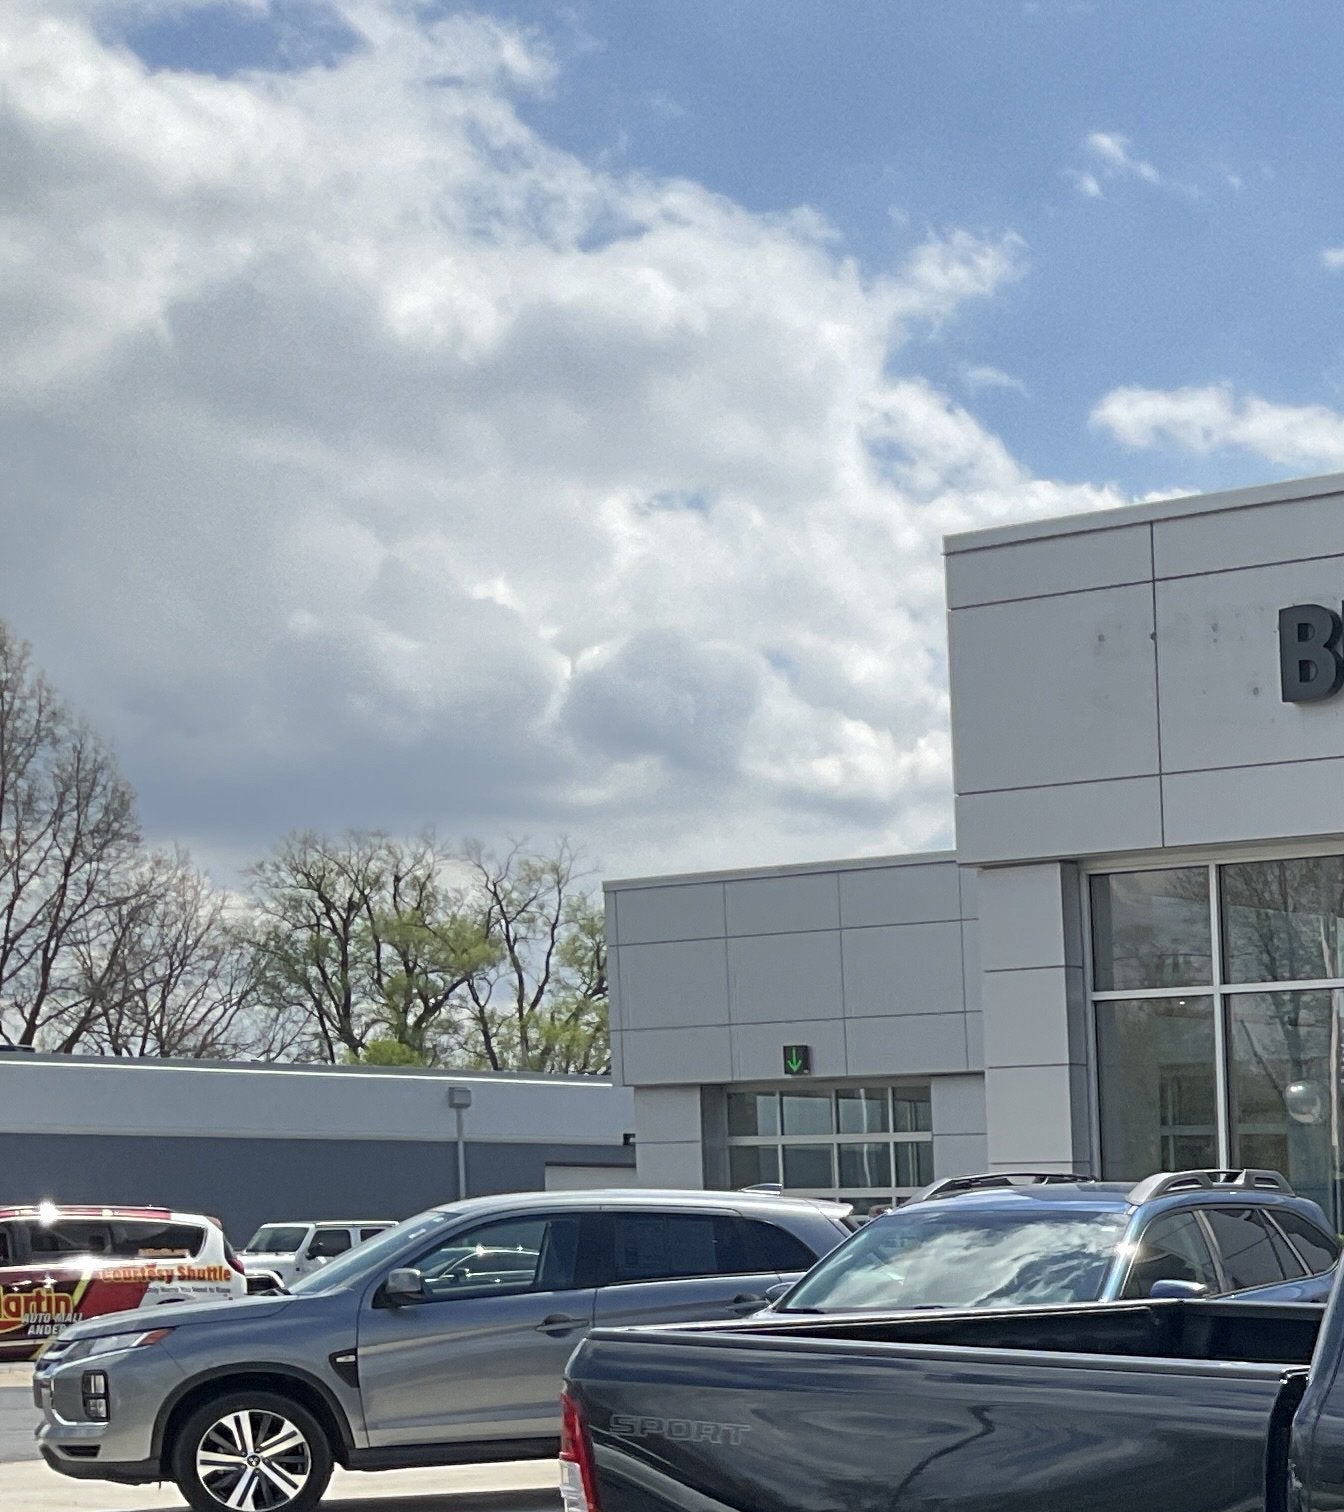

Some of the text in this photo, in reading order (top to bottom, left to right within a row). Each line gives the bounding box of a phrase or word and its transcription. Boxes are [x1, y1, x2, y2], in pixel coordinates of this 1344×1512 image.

[101, 1264, 232, 1284] Courtesy Shuttle
[0, 1285, 73, 1320] artin
[22, 1313, 51, 1324] AUTO
[609, 1414, 750, 1445] SPORT
